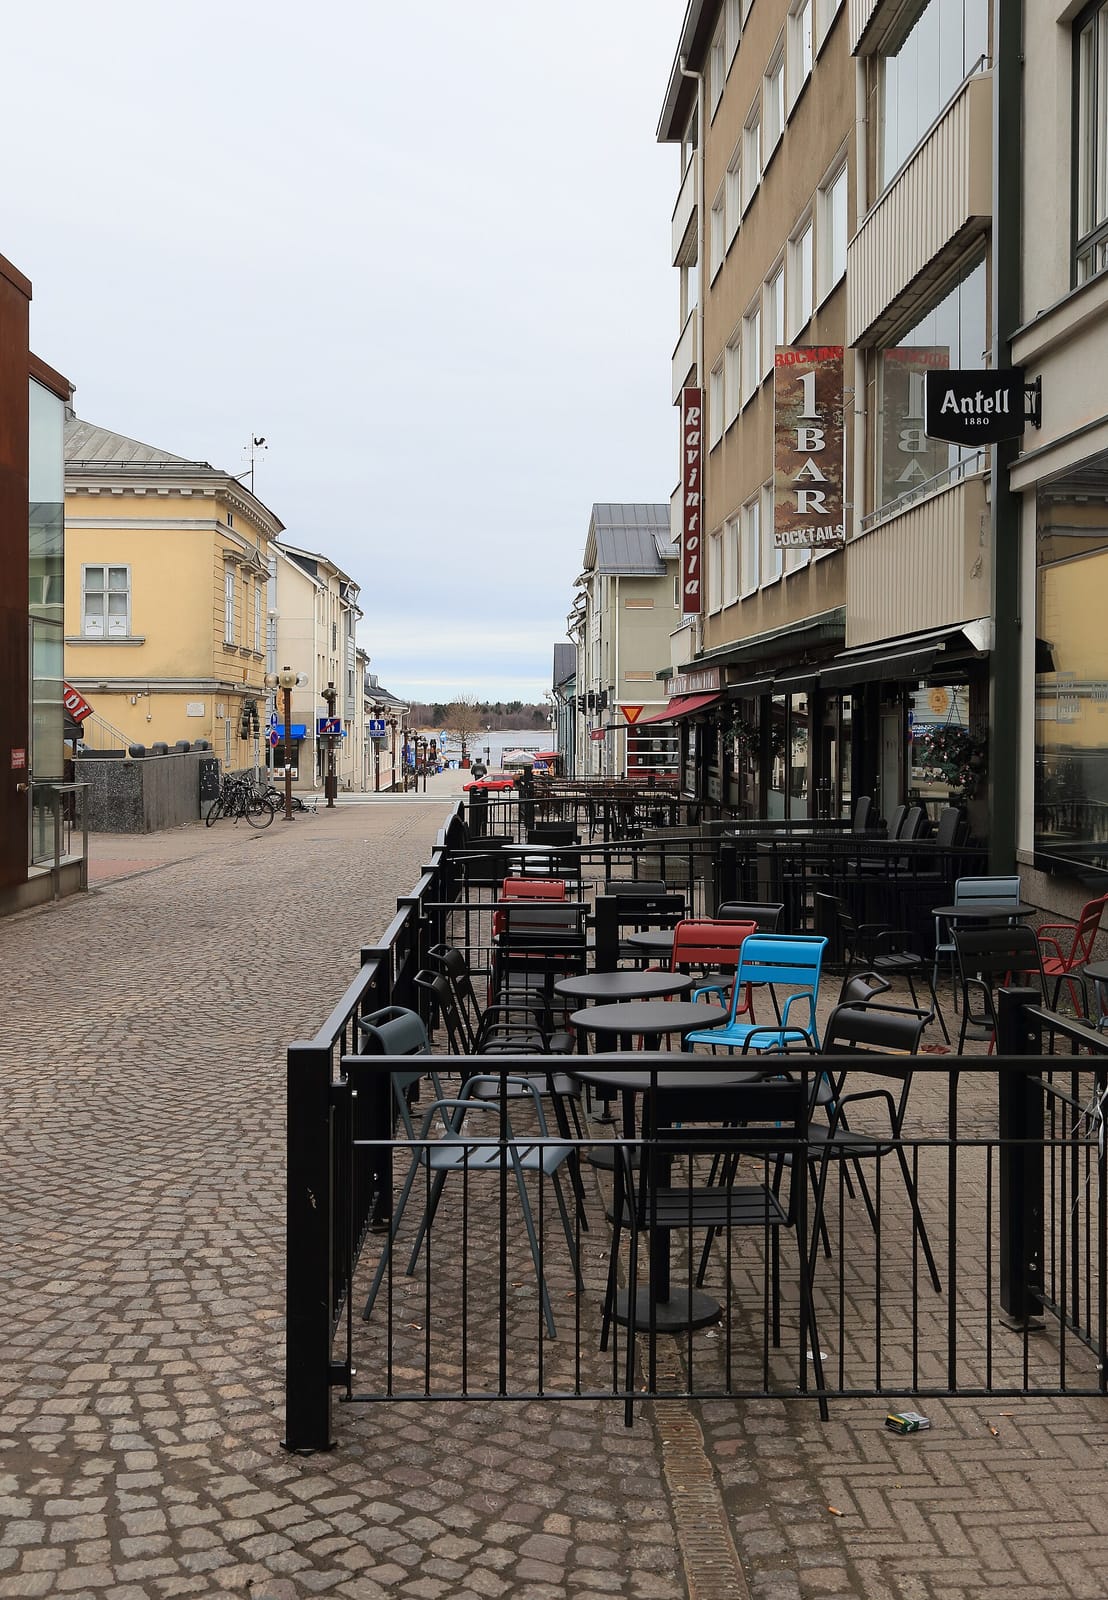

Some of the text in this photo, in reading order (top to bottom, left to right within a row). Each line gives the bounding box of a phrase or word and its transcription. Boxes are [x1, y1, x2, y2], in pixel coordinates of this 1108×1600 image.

[940, 389, 1010, 414] Antell
[964, 417, 990, 425] 1880
[793, 371, 831, 514] 1 BAR
[685, 407, 701, 594] Ravintola
[774, 524, 844, 546] COCKTAILS
